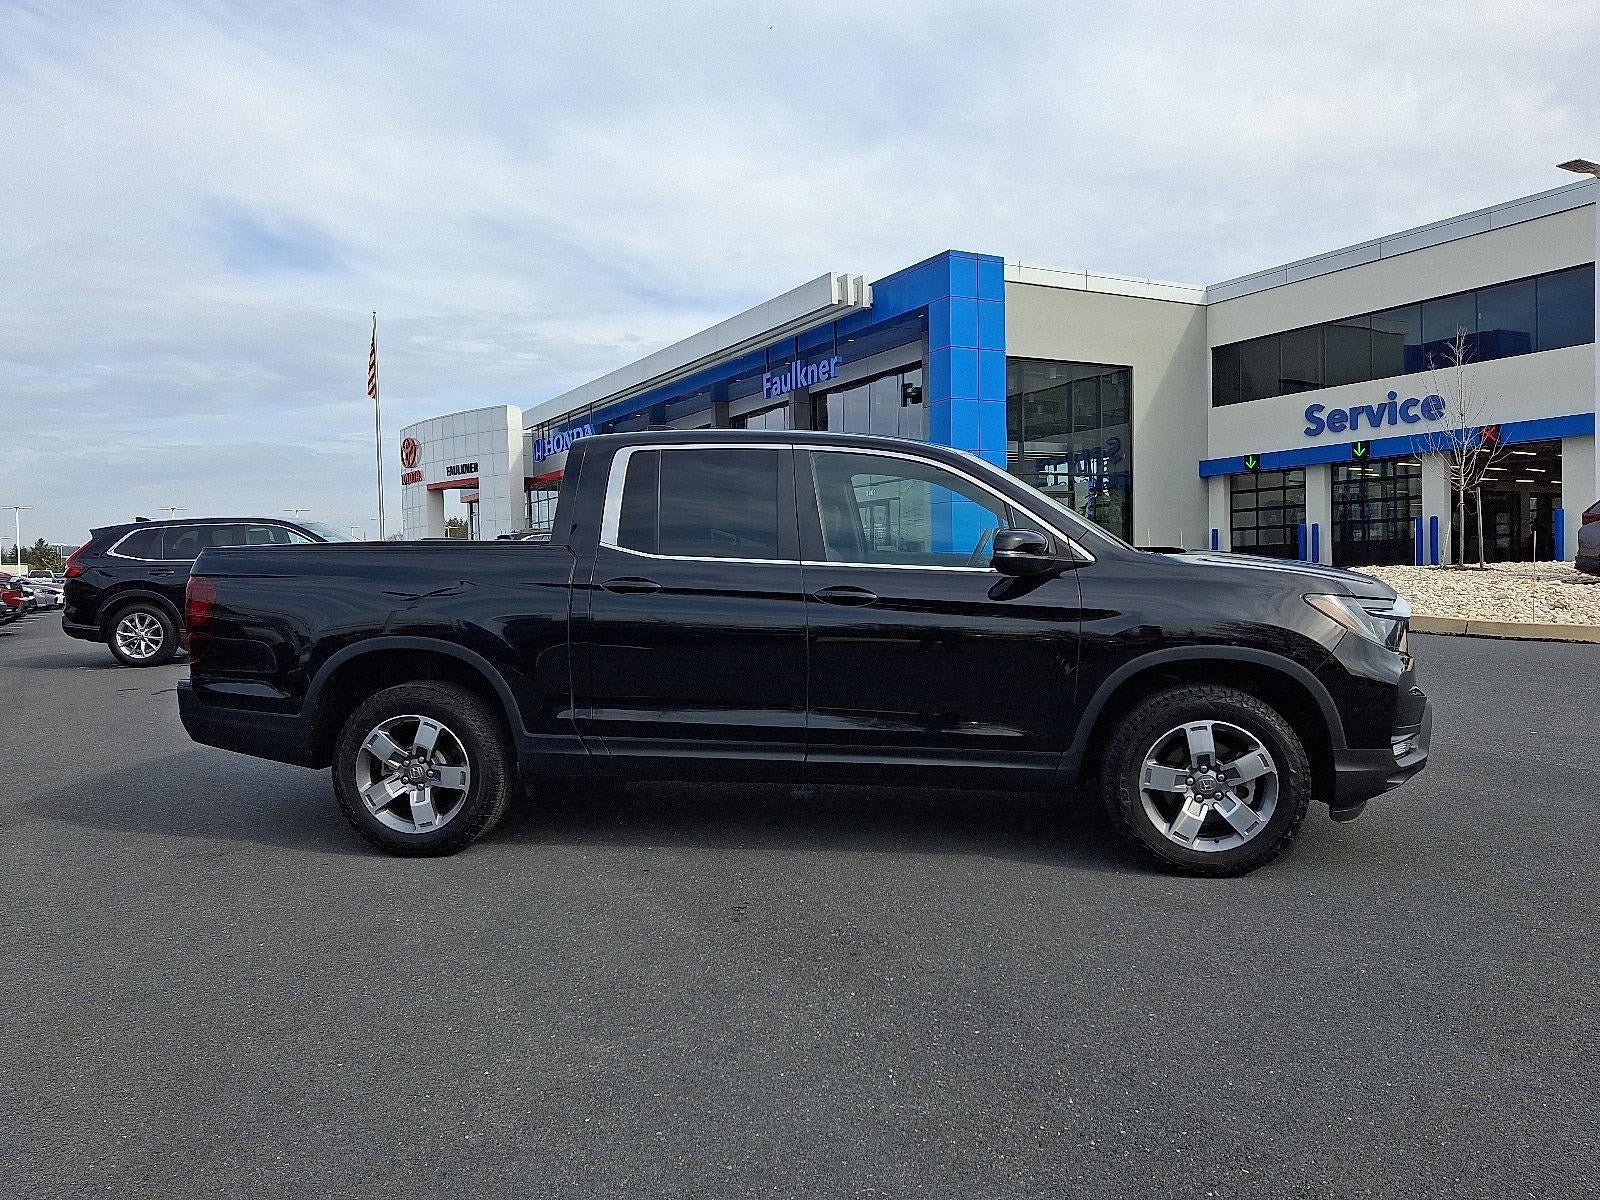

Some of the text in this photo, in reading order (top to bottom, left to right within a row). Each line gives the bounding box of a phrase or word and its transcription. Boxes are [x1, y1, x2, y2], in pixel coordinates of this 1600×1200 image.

[762, 356, 842, 399] Faulkner
[1304, 390, 1446, 437] Service
[544, 423, 596, 457] HONDA
[446, 462, 479, 476] FAULKNER
